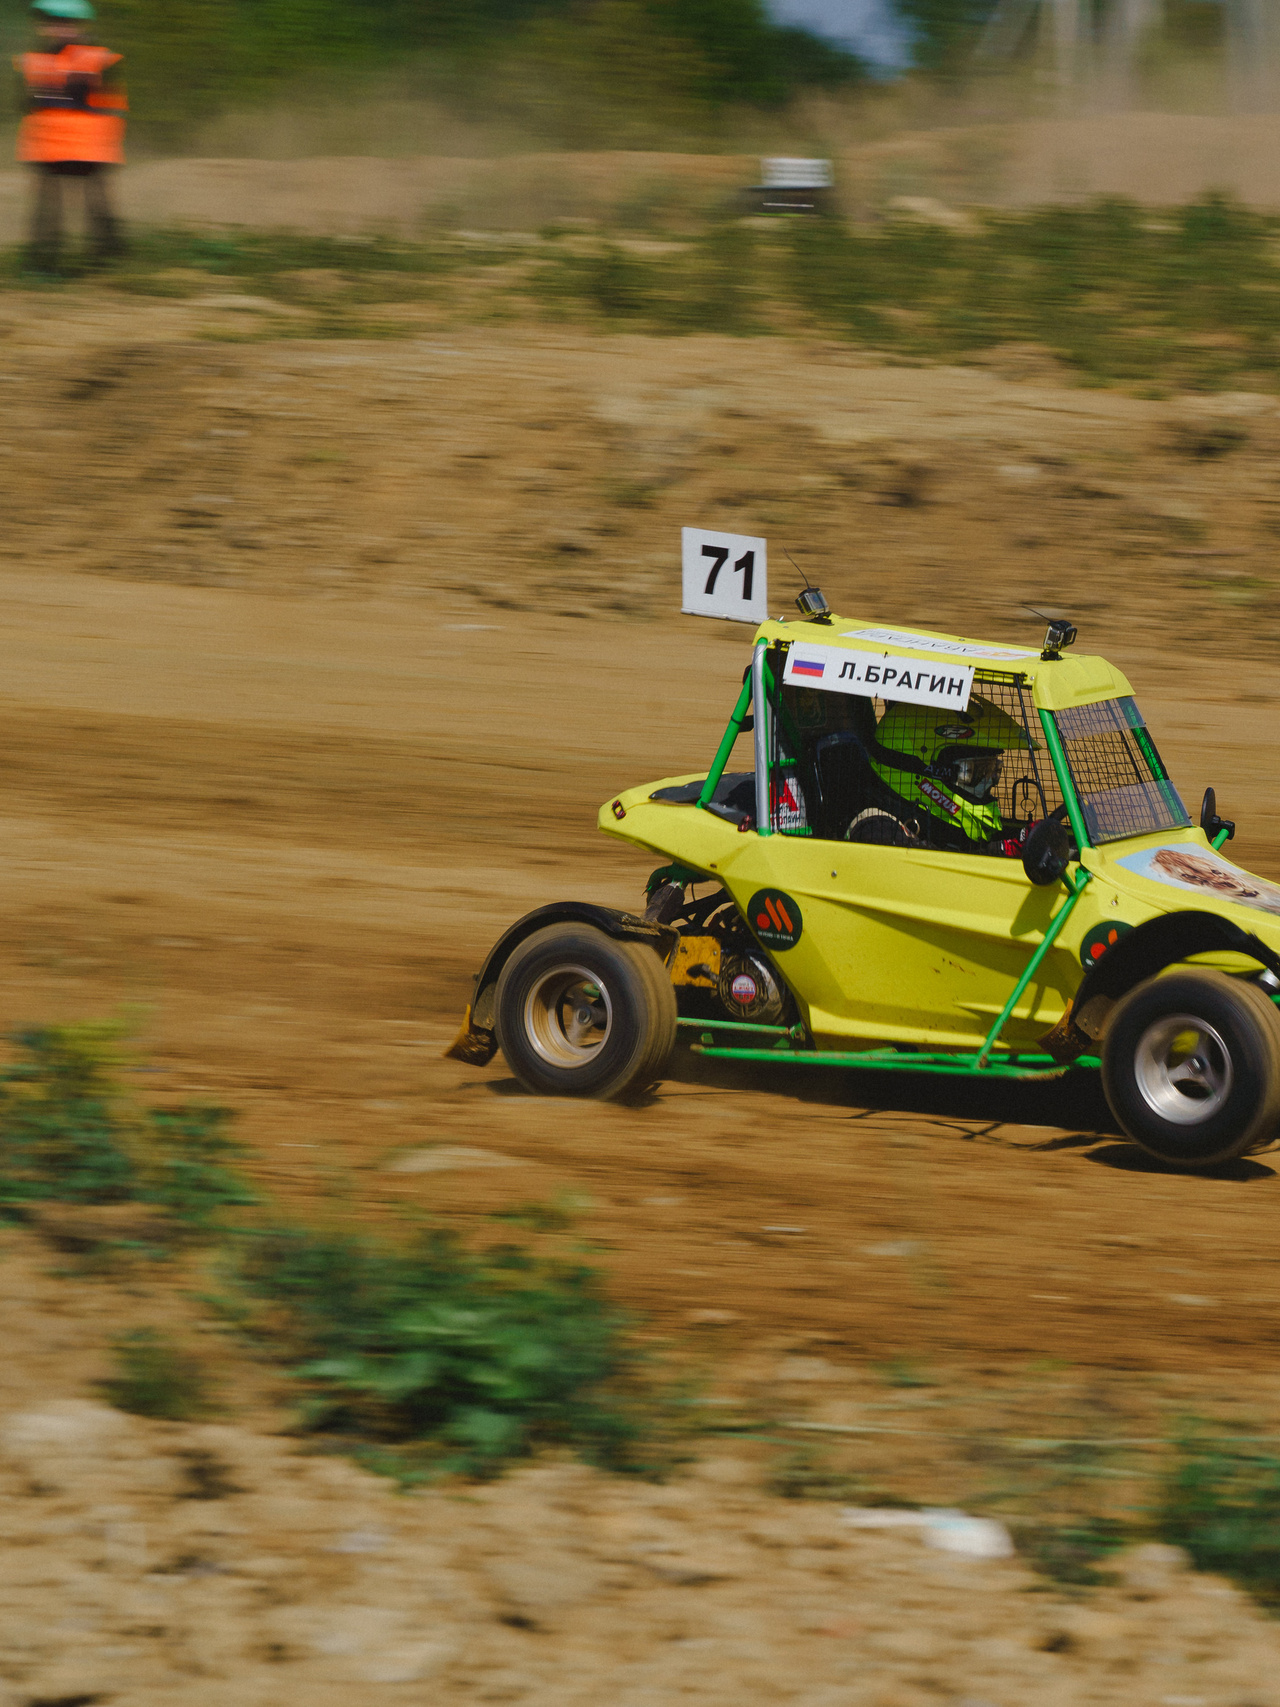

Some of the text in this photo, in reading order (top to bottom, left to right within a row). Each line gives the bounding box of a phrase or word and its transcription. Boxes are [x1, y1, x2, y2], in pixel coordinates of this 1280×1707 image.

[701, 544, 755, 600] 71
[838, 661, 965, 697] Л.БРАГИН
[921, 782, 958, 814] MOTUL
